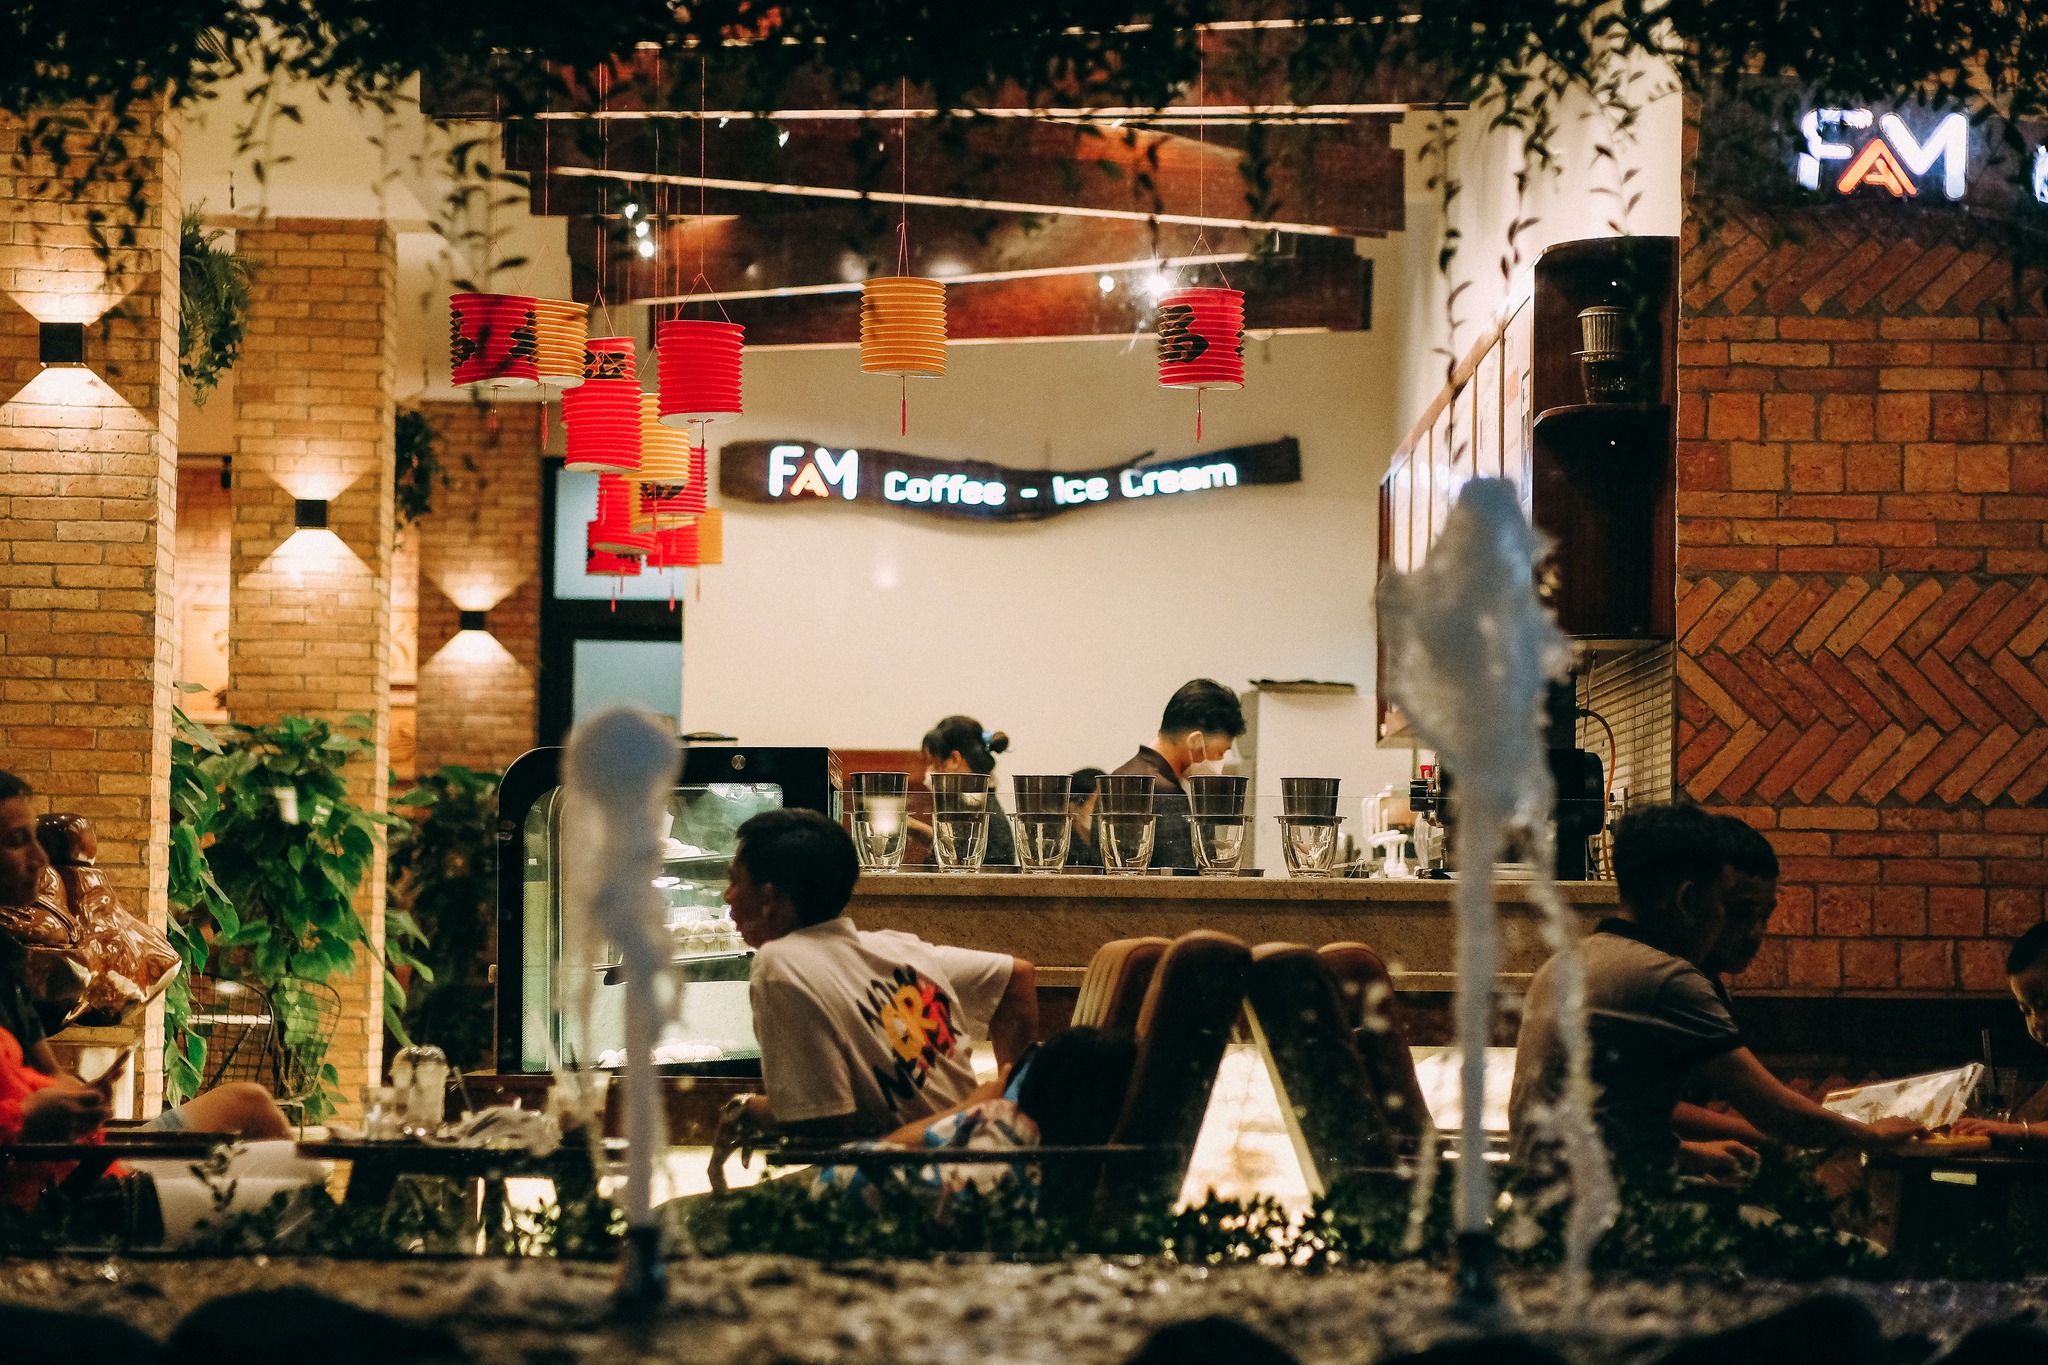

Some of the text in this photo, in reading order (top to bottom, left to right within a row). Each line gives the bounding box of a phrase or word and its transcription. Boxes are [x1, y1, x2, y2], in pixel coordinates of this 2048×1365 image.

[1797, 108, 1969, 199] FAM
[768, 445, 859, 501] FAM
[883, 470, 1007, 506] Coffee
[1052, 475, 1109, 505] Ice
[1119, 462, 1238, 499] Cream
